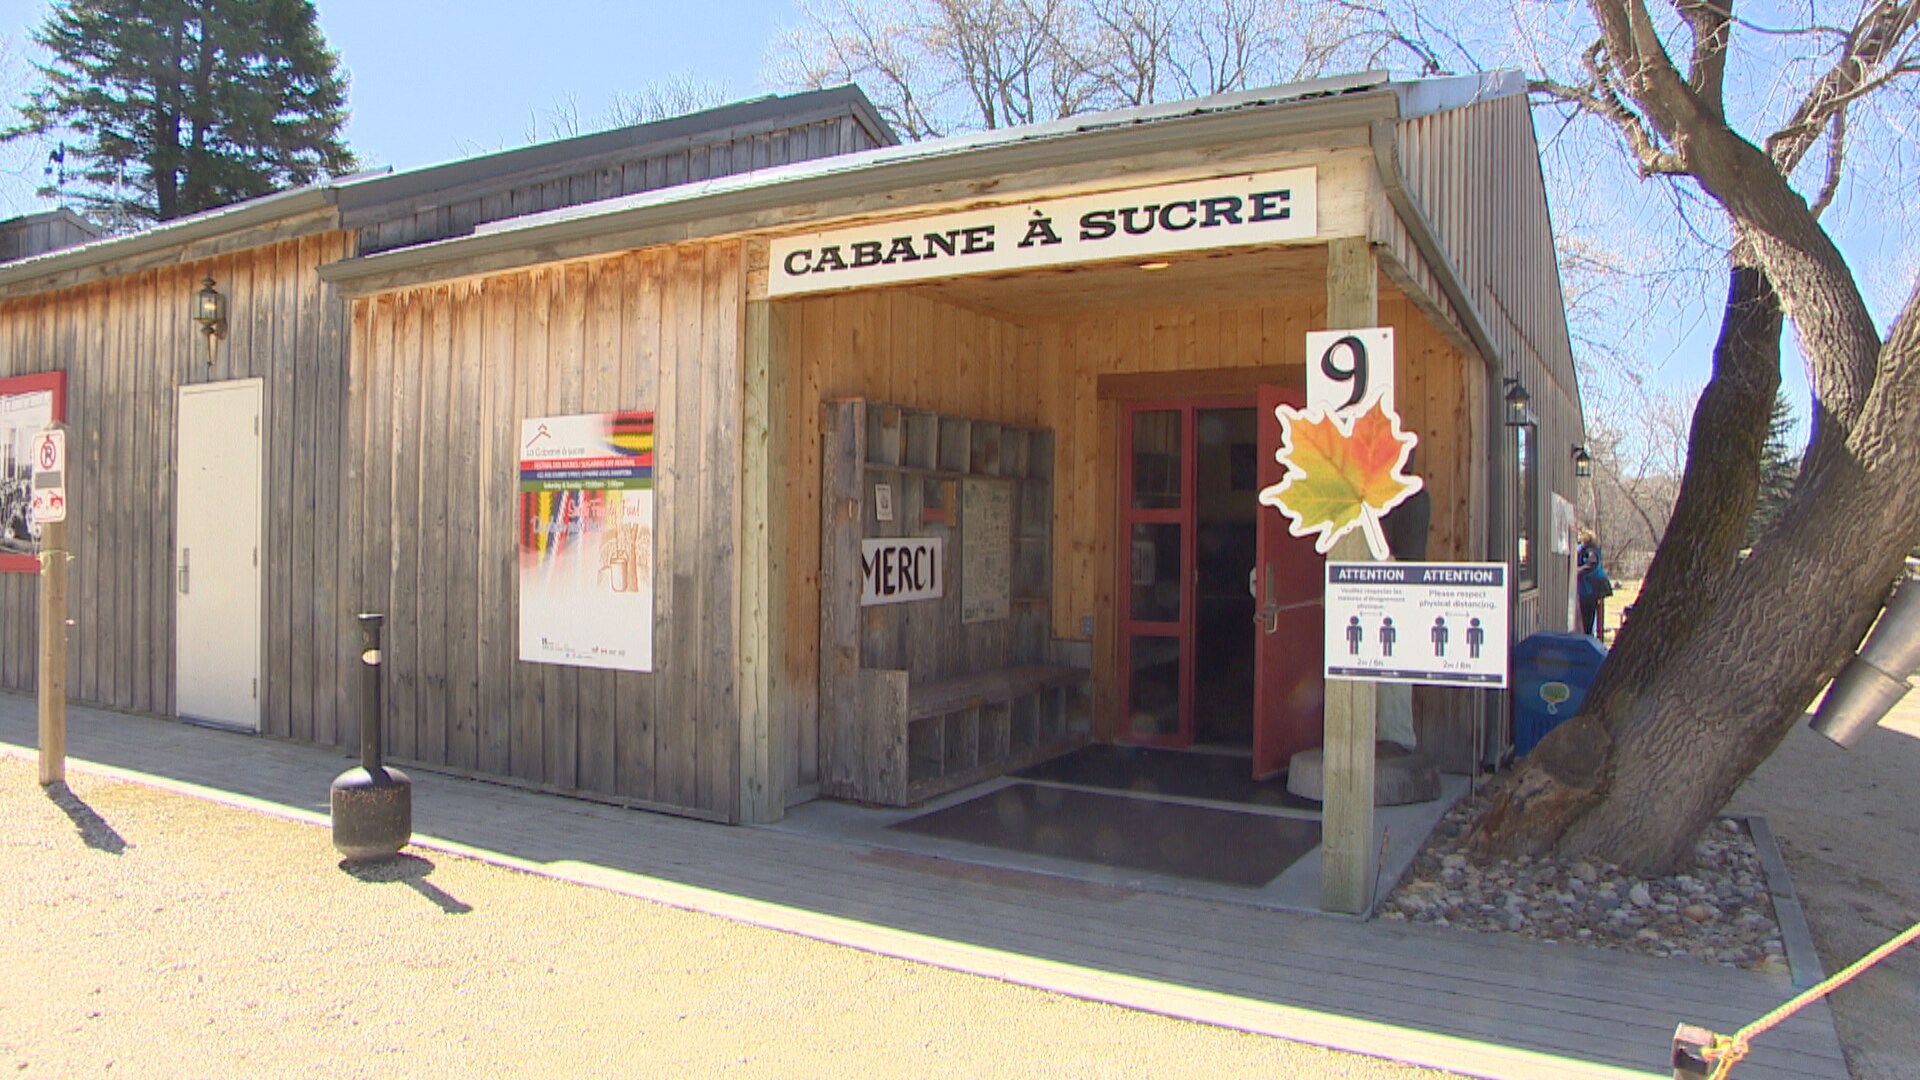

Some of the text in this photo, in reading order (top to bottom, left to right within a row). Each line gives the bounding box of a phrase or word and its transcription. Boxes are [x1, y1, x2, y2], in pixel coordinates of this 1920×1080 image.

[784, 189, 1291, 276] CABANE À SUCRE
[1321, 335, 1367, 412] 9
[862, 545, 936, 596] MERCI
[1338, 569, 1405, 581] ATTENTION
[1423, 569, 1493, 583] ATTENTION
[1428, 589, 1486, 599] Please respect
[1419, 599, 1497, 610] physical distancing.
